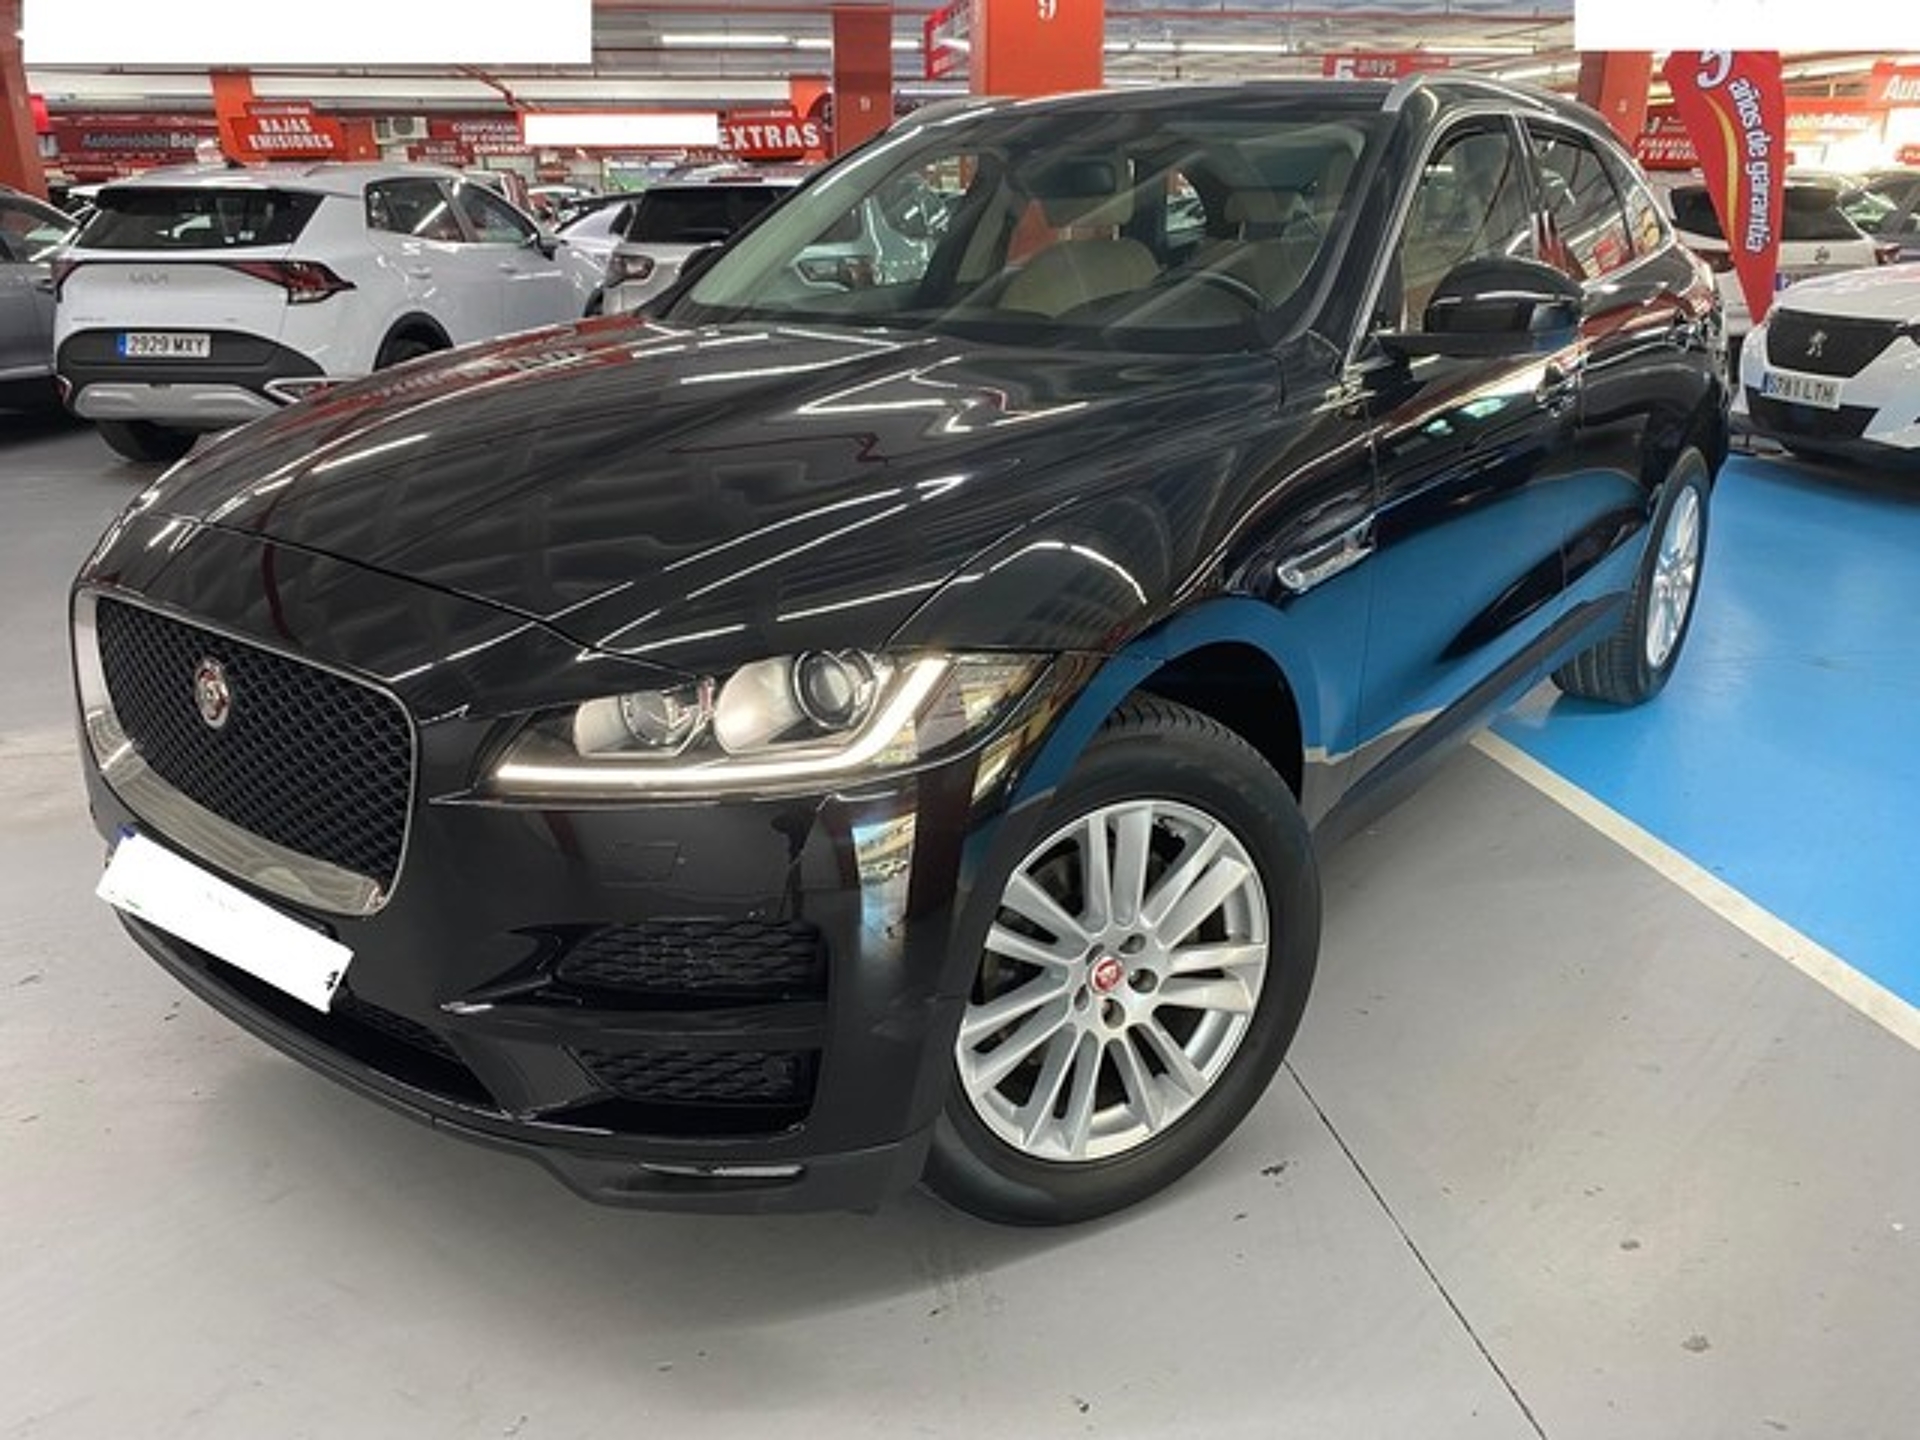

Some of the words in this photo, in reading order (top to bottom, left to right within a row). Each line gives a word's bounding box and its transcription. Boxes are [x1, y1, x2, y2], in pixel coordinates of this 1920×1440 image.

[259, 119, 312, 133] BAJAS
[1728, 78, 1762, 129] años
[1745, 130, 1771, 157] de
[248, 134, 334, 150] EMISIONES
[717, 122, 820, 151] EXTRAS
[130, 335, 170, 353] 2929
